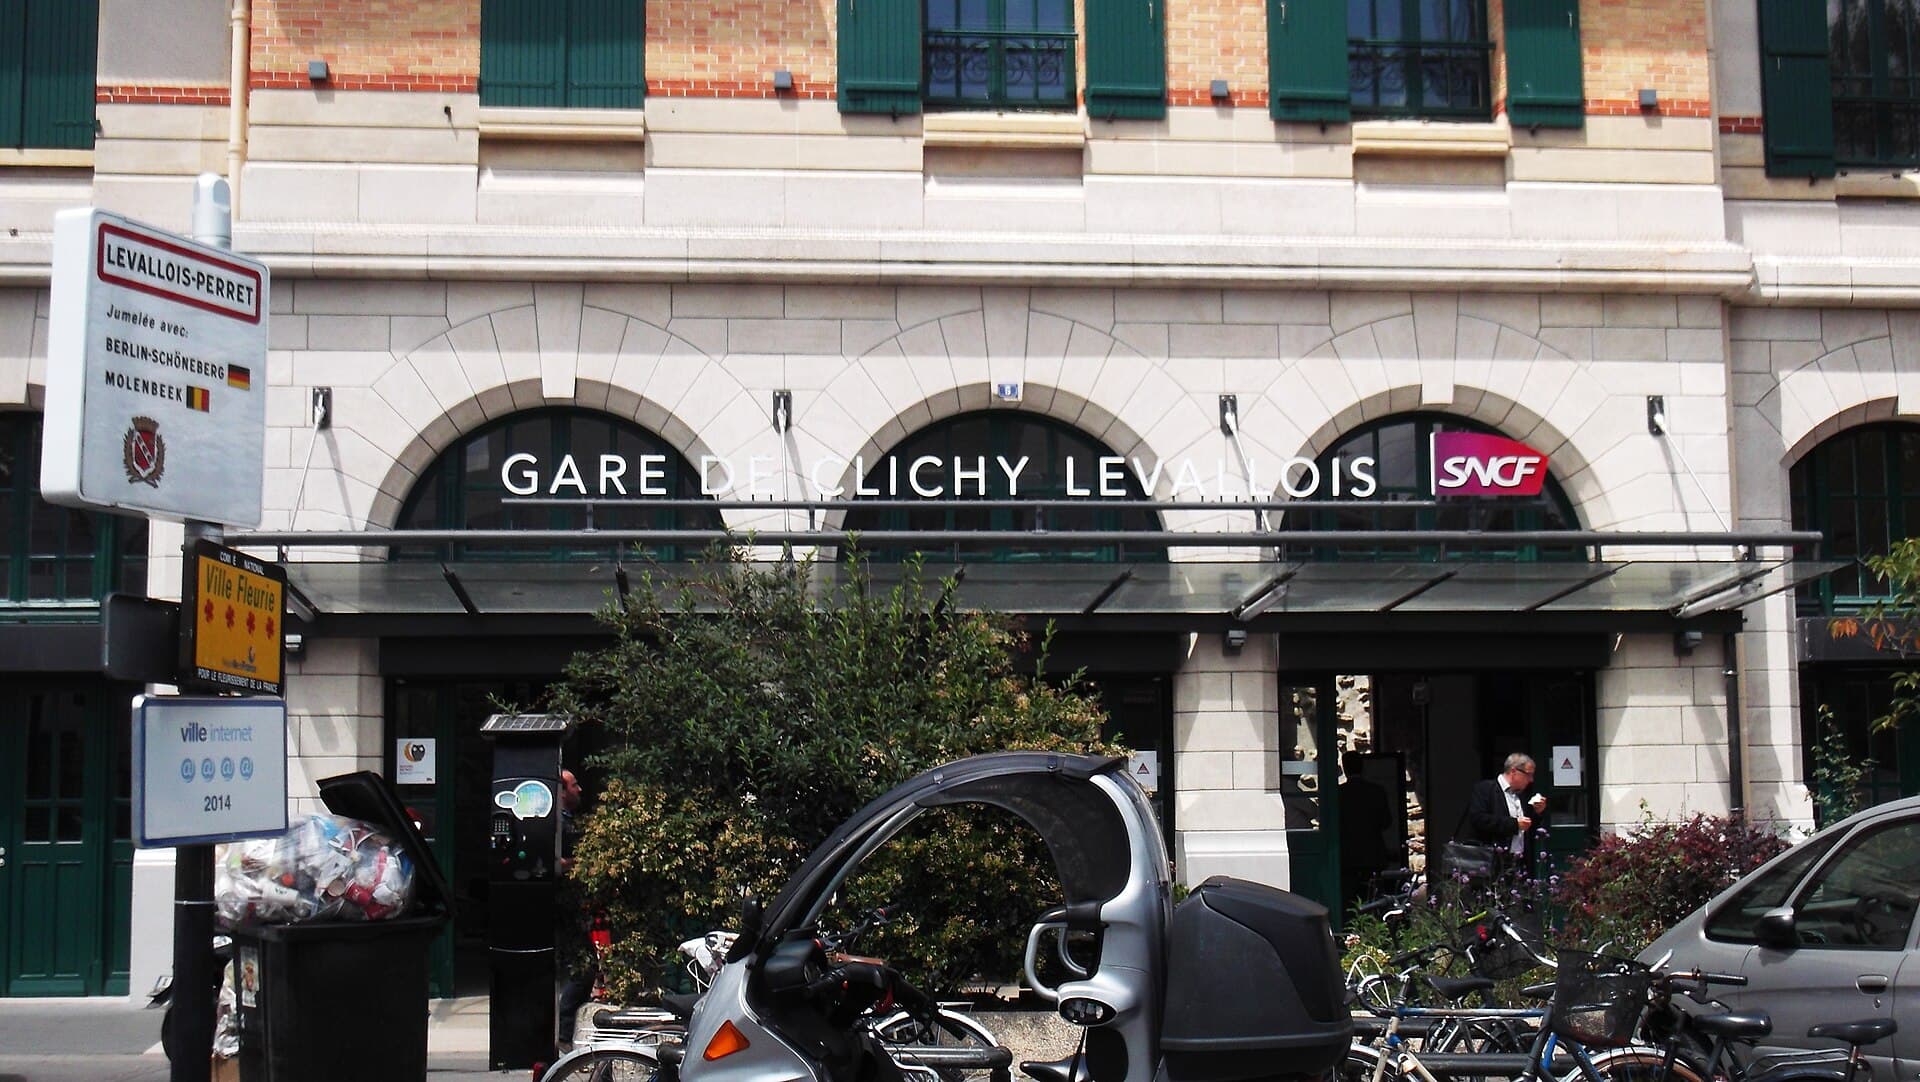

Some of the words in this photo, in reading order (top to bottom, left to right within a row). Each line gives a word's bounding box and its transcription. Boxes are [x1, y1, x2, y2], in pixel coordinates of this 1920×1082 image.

[106, 243, 254, 307] LEVALLOIS-PERRET
[106, 303, 156, 329] Jumelée
[105, 336, 225, 380] BERLIN-SCHÖNEBERG
[105, 369, 183, 404] MOLENBEEK
[501, 453, 668, 497] GARE
[701, 454, 775, 496] DE
[811, 454, 1031, 498] CLICHY
[1065, 455, 1377, 499] LEVALLOIS
[1437, 455, 1542, 489] SNCF
[206, 563, 233, 600] Ville
[236, 574, 275, 612] Fleurie
[211, 670, 217, 681] LE
[180, 721, 208, 743] ville
[209, 723, 253, 743] internet
[203, 794, 232, 813] 2014
